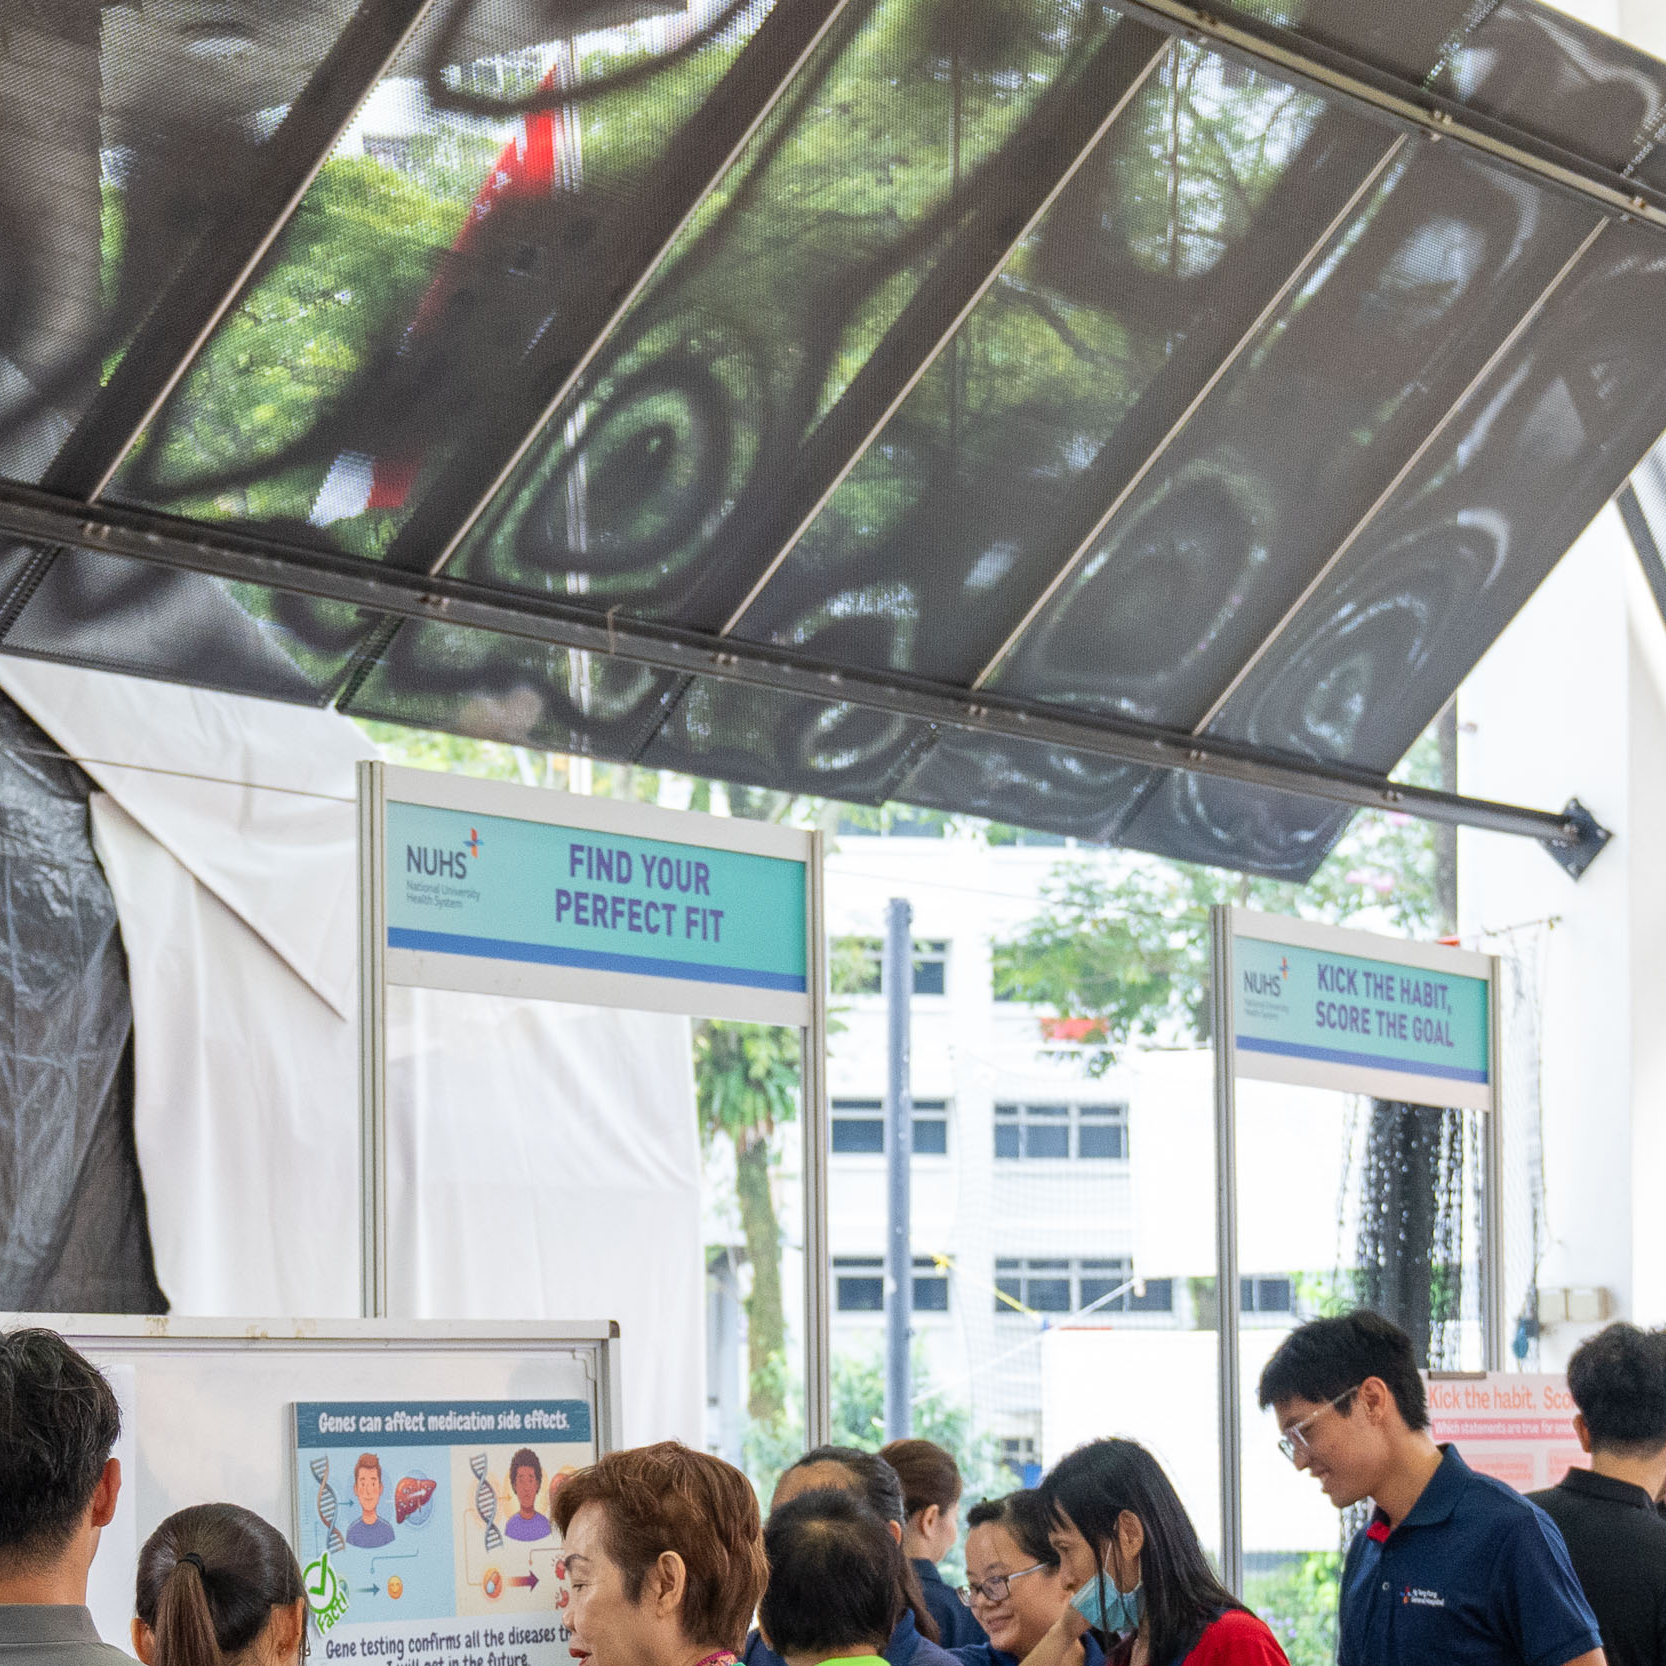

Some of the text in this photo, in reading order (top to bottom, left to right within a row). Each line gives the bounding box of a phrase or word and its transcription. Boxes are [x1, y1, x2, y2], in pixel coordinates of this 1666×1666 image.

[406, 845, 467, 880] NUHS
[569, 843, 711, 896] FIND YOUR
[555, 888, 724, 943] PERFECT FIT
[1243, 970, 1281, 998] NUHS
[1317, 963, 1452, 1016] KICK THE HABIT,
[1315, 1001, 1371, 1035] SCORE
[1375, 1009, 1408, 1041] THE
[1412, 1015, 1455, 1048] GOAL
[1428, 1384, 1577, 1413] Kick the habit, Sco
[319, 1408, 570, 1434] Genes can affect medication side effects.
[326, 1638, 357, 1660] Gene
[359, 1635, 404, 1661] testing
[408, 1630, 461, 1653] confirms
[465, 1628, 480, 1649] all
[483, 1627, 505, 1648] the
[508, 1625, 556, 1646] diseases
